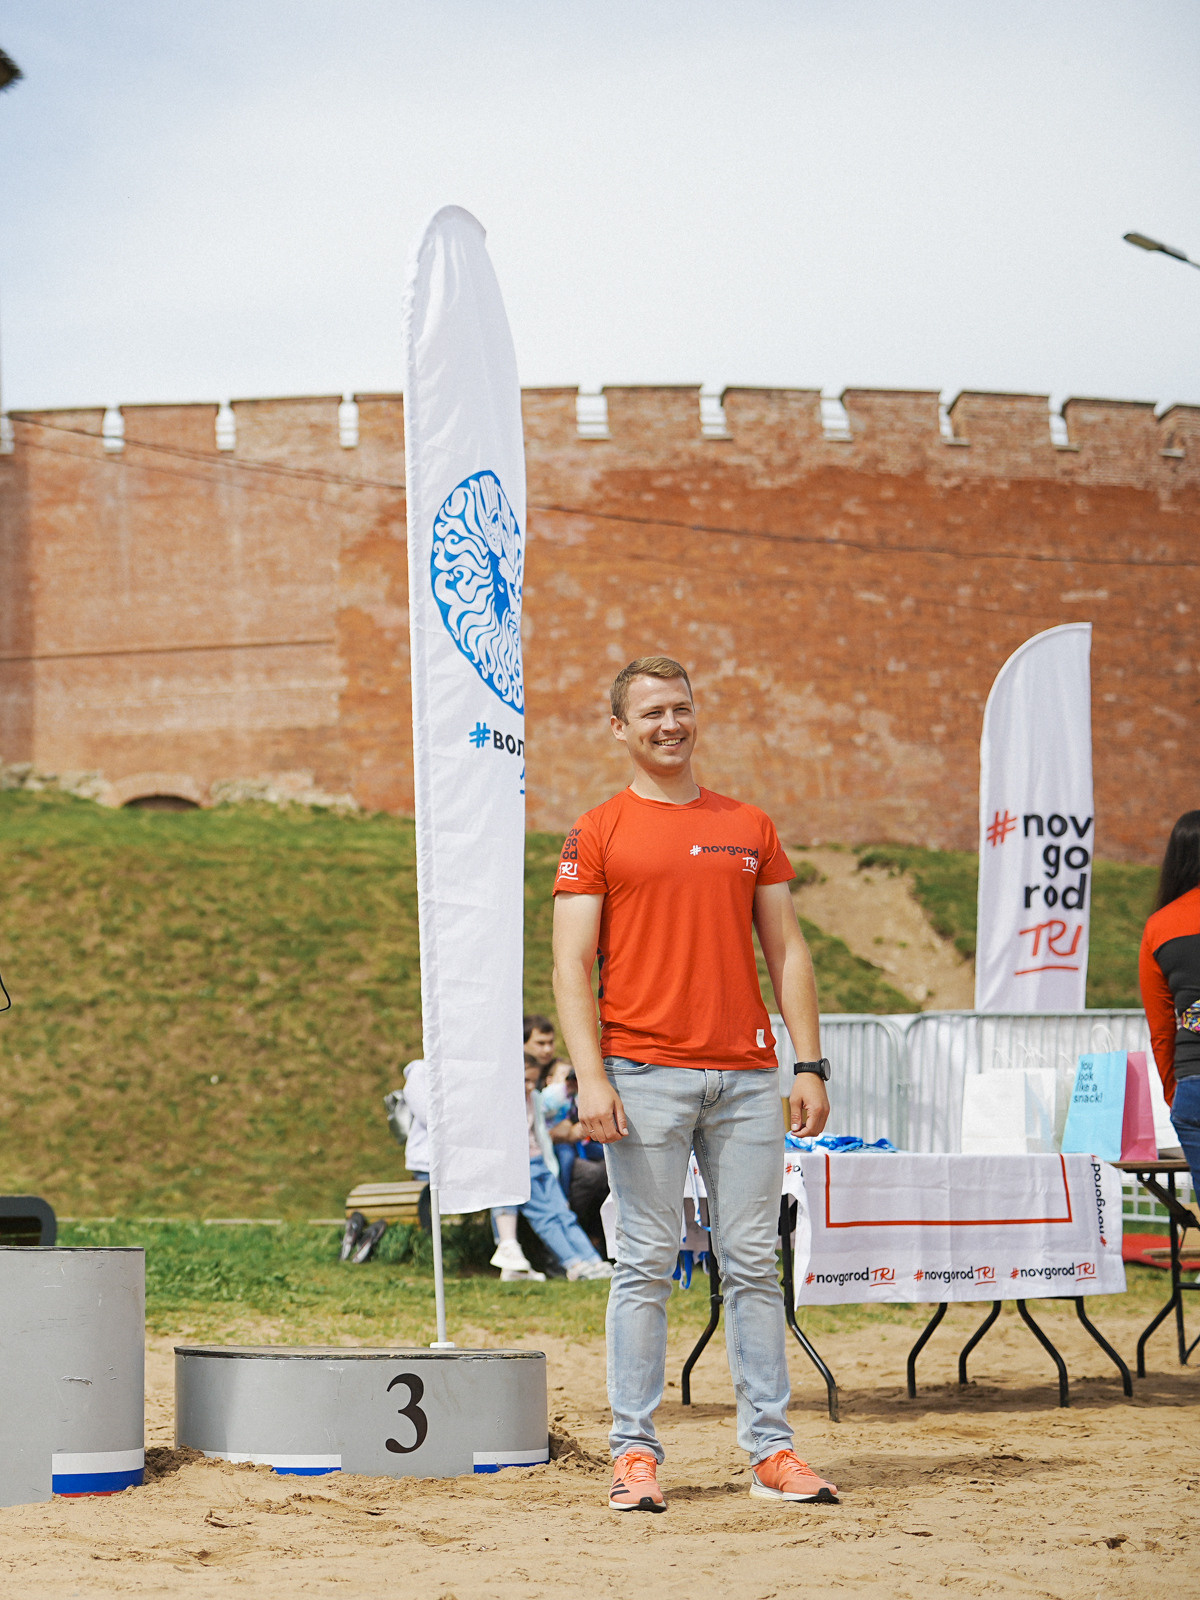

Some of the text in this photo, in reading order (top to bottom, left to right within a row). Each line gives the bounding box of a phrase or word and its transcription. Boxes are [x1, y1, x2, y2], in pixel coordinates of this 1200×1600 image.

[986, 809, 1093, 847] #nov
[689, 844, 759, 859] #novgorod
[1043, 844, 1090, 879] go
[1024, 873, 1087, 910] rod
[1019, 919, 1083, 957] TRI
[1073, 1092, 1103, 1103] snack!
[1092, 1084, 1098, 1092] a
[385, 1373, 428, 1454] 3
